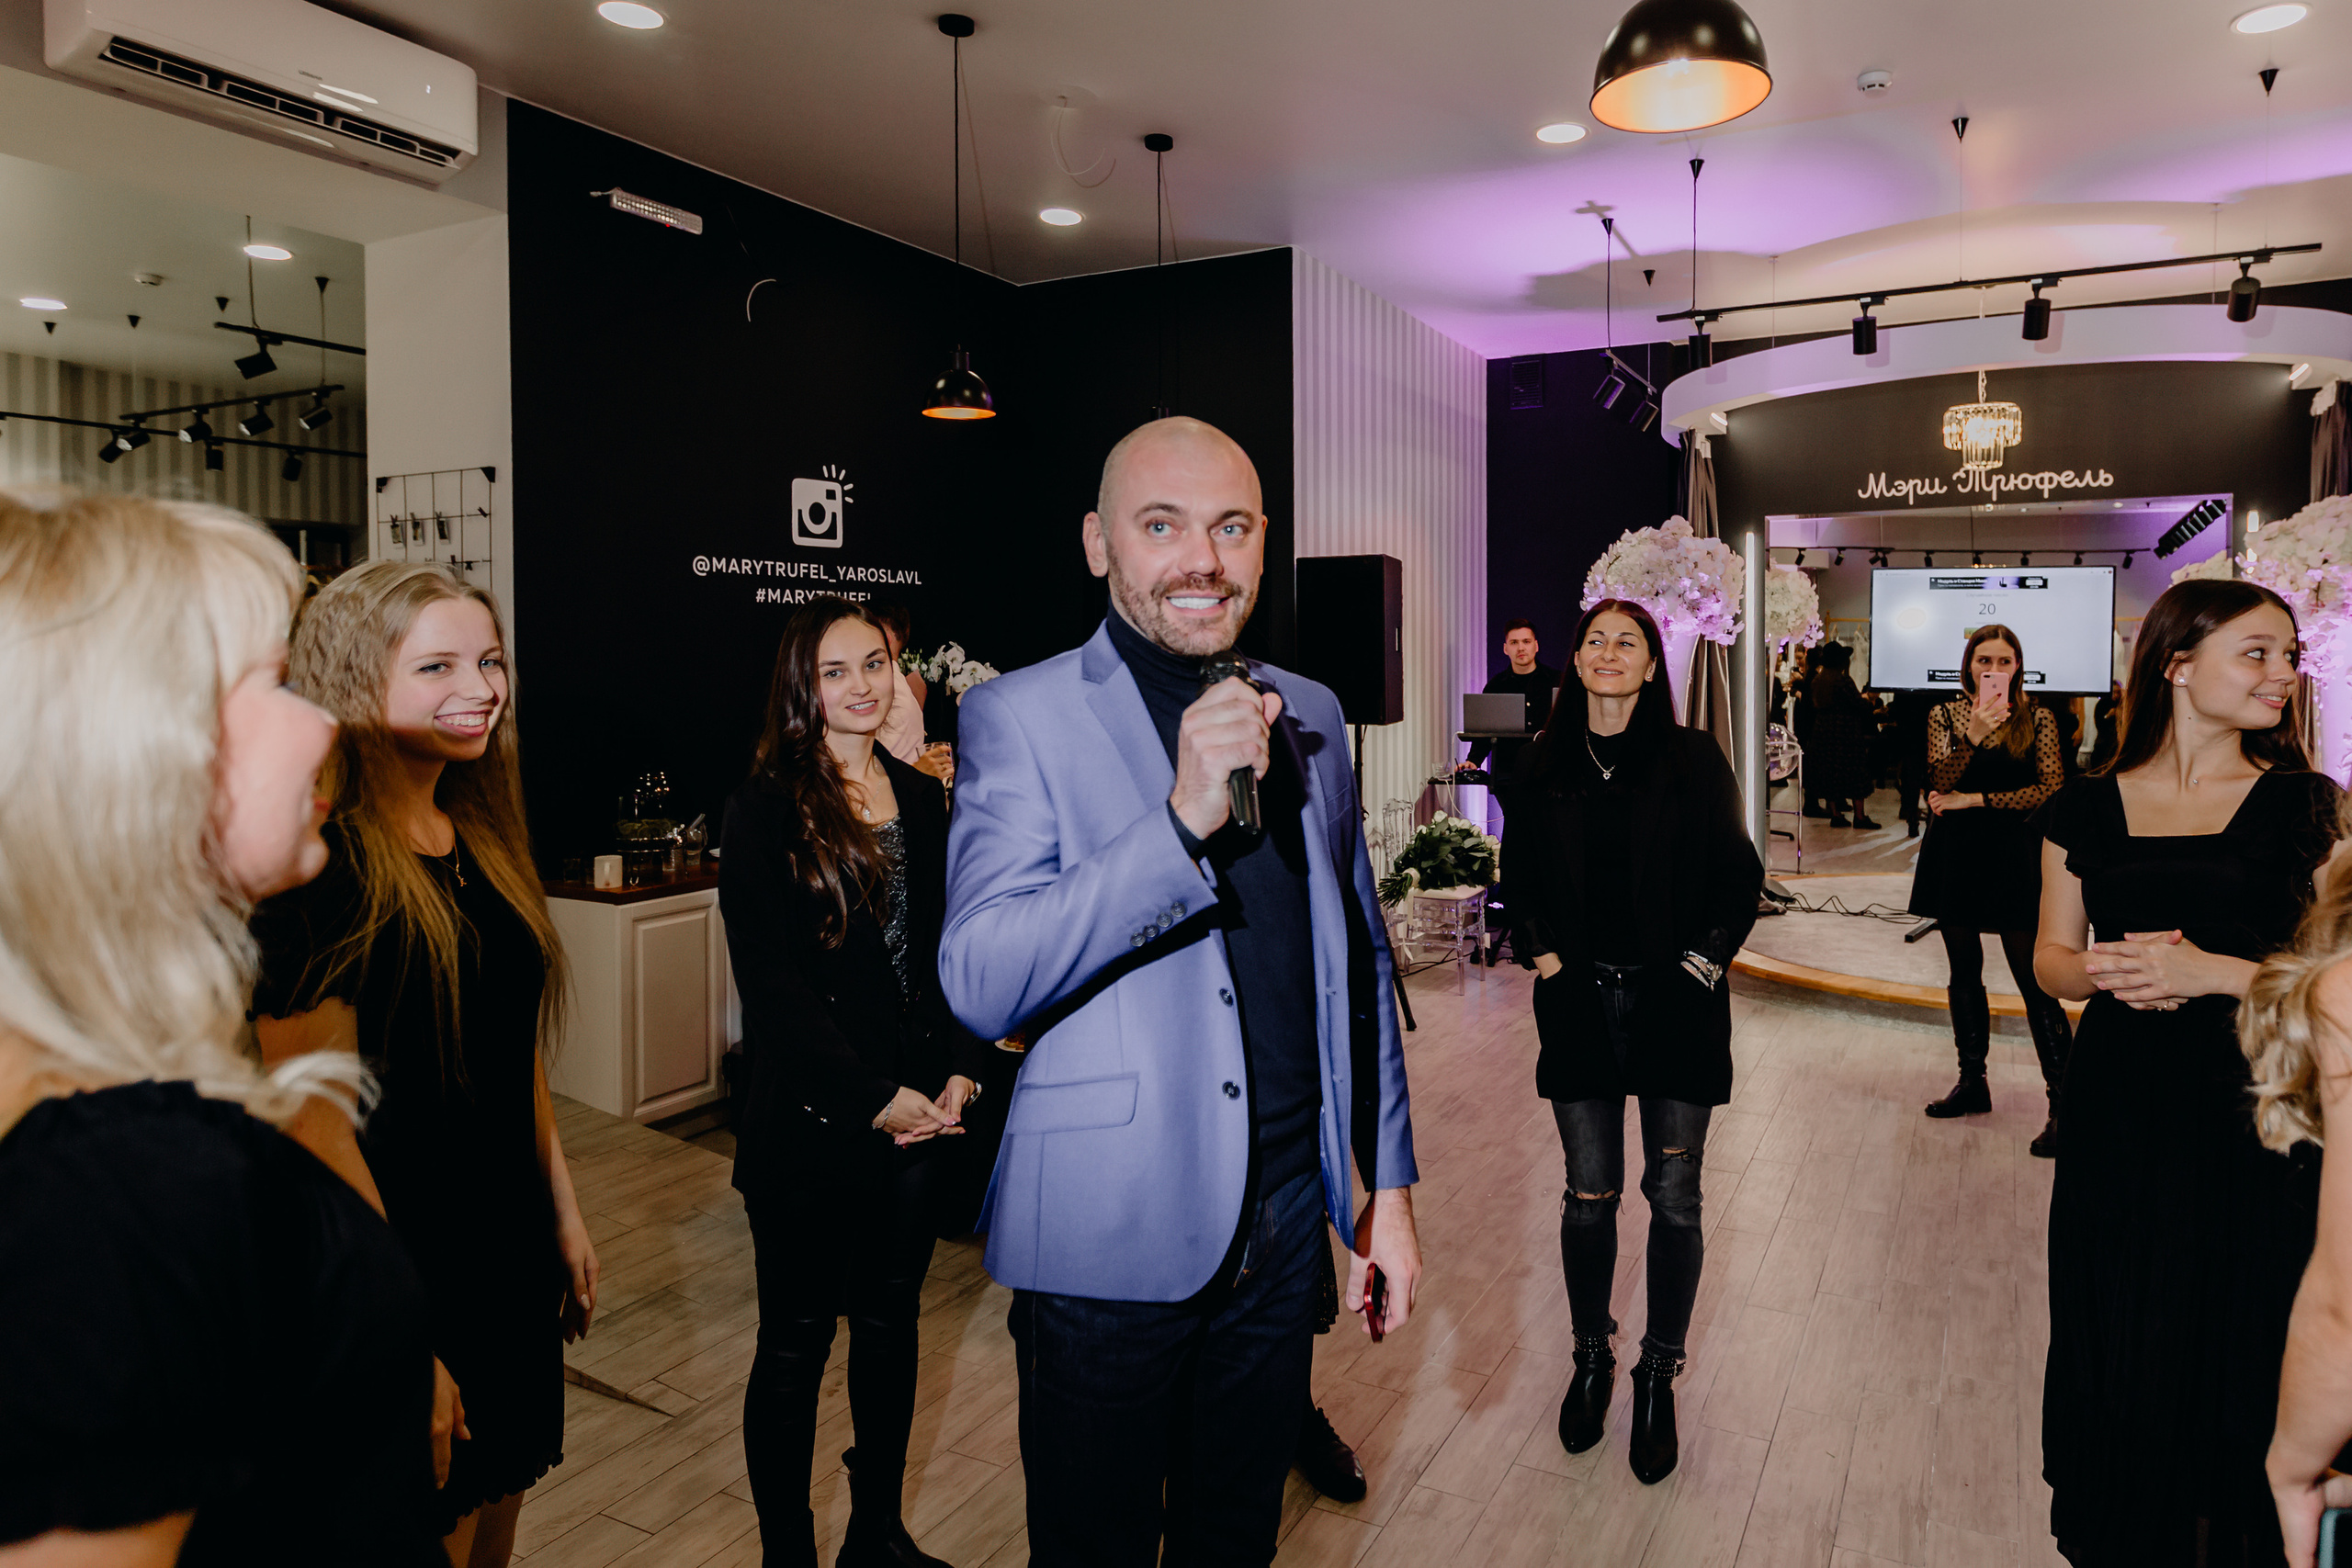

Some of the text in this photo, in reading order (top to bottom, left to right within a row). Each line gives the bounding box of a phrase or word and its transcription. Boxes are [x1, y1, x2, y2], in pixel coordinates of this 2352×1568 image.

[1857, 467, 2114, 505] Мэри Трюфель
[692, 555, 922, 585] @MARYTRUFEL_YAROSLAVL
[1978, 603, 1996, 615] 20
